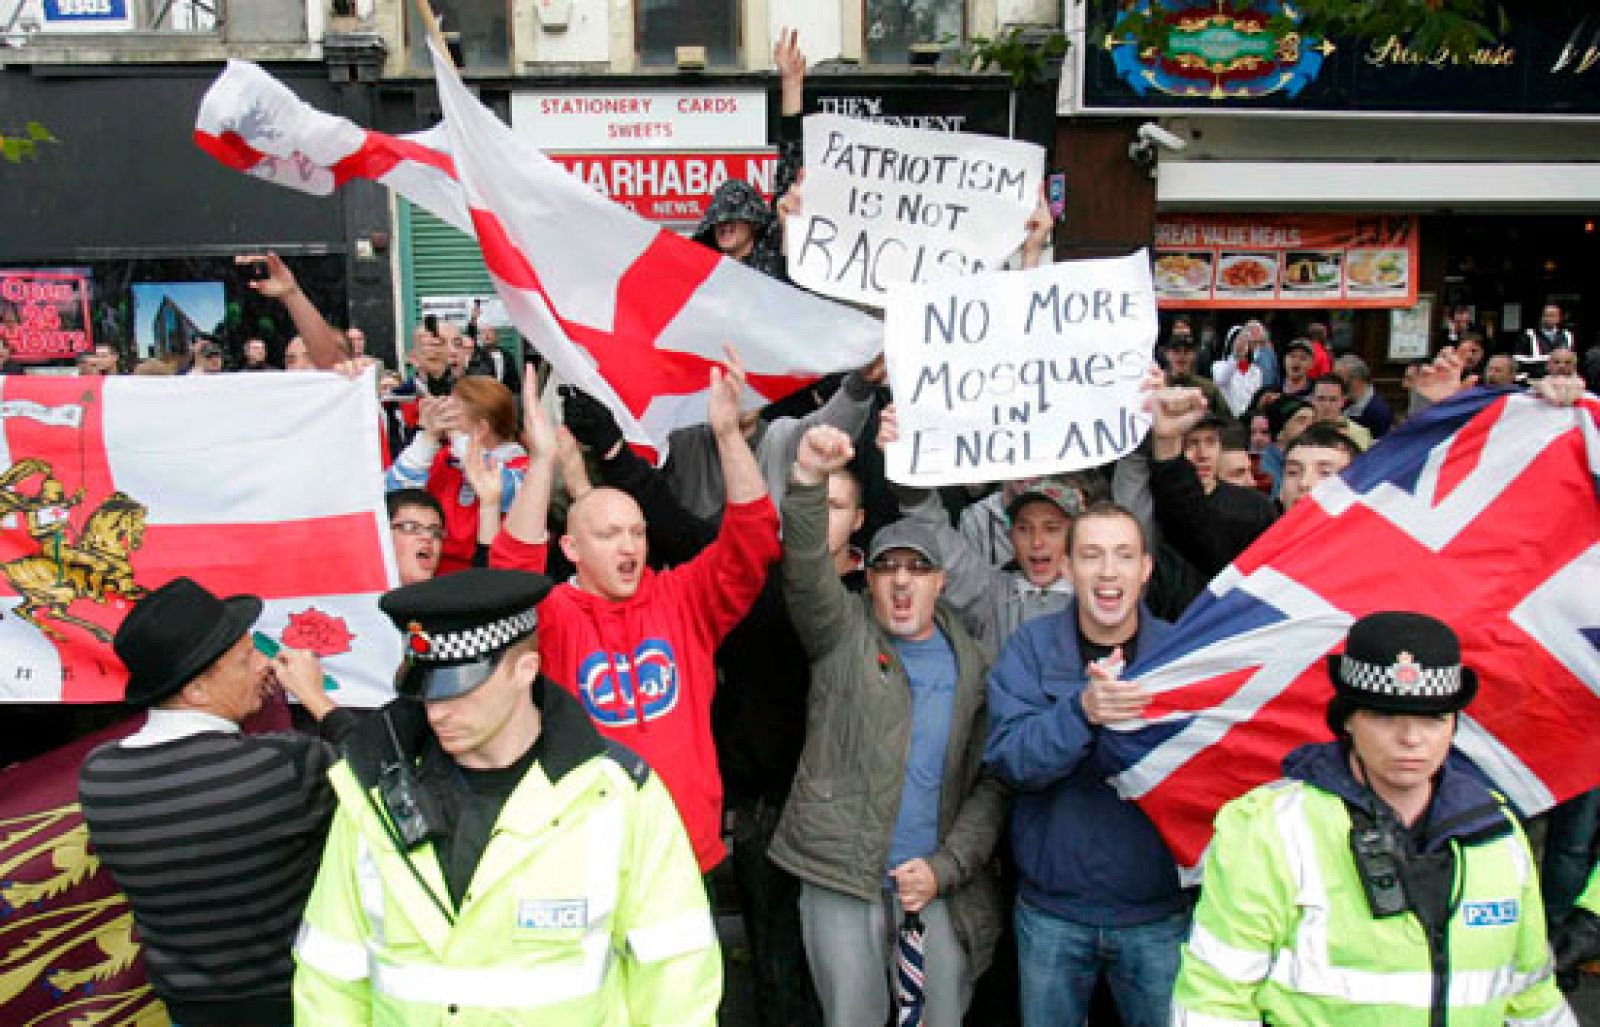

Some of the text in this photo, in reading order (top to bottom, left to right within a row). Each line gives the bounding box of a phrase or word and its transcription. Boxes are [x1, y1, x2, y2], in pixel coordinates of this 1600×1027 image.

[540, 98, 738, 115] STATIONERY CARDS
[608, 121, 673, 139] SWEETS
[820, 130, 1026, 202] PATRIOTISM
[848, 184, 969, 232] IS NOT
[1202, 226, 1249, 246] VALUE
[1250, 227, 1303, 246] MEALS
[924, 284, 1143, 344] NO MORE
[910, 350, 1145, 413] Mosques
[991, 401, 1031, 425] IN
